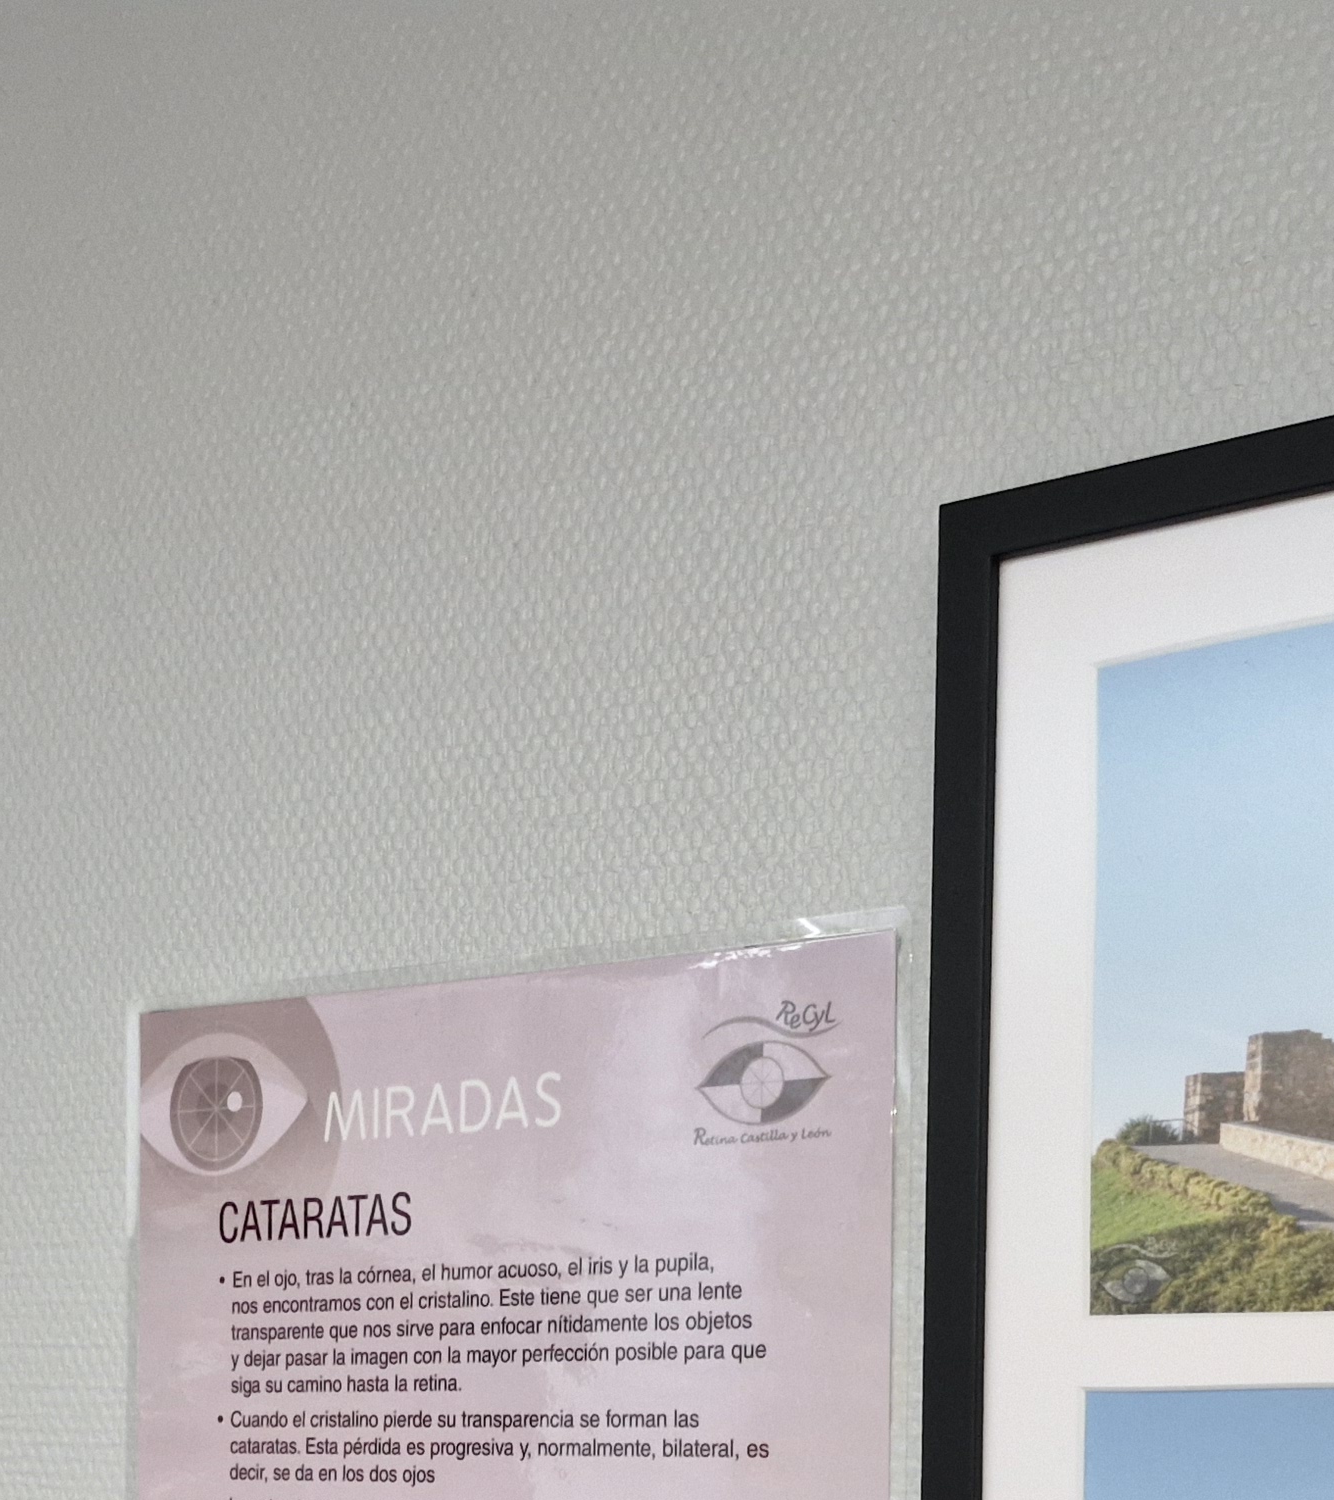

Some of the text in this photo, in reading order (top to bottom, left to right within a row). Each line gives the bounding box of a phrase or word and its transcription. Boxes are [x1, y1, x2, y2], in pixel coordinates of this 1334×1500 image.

[323, 1072, 563, 1143] MIRADAS
[693, 1127, 737, 1146] Retina
[740, 1129, 788, 1144] Castilla
[218, 1191, 413, 1244] CATARATAS
[233, 1252, 714, 1290] En el ojo, tras la córnea, el humor acuoso, el iris y la pupila,
[232, 1282, 742, 1314] nos encontramos con el cristalino. Este tiene que ser una lente
[231, 1311, 752, 1344] transparente que nos sirve para enfocar nítidamente los objetos
[230, 1437, 769, 1461] cataratas. Esta pérdida es progresiva y, normalmente, bilateral, es
[229, 1463, 435, 1487] decir, se da en los dos ojos
